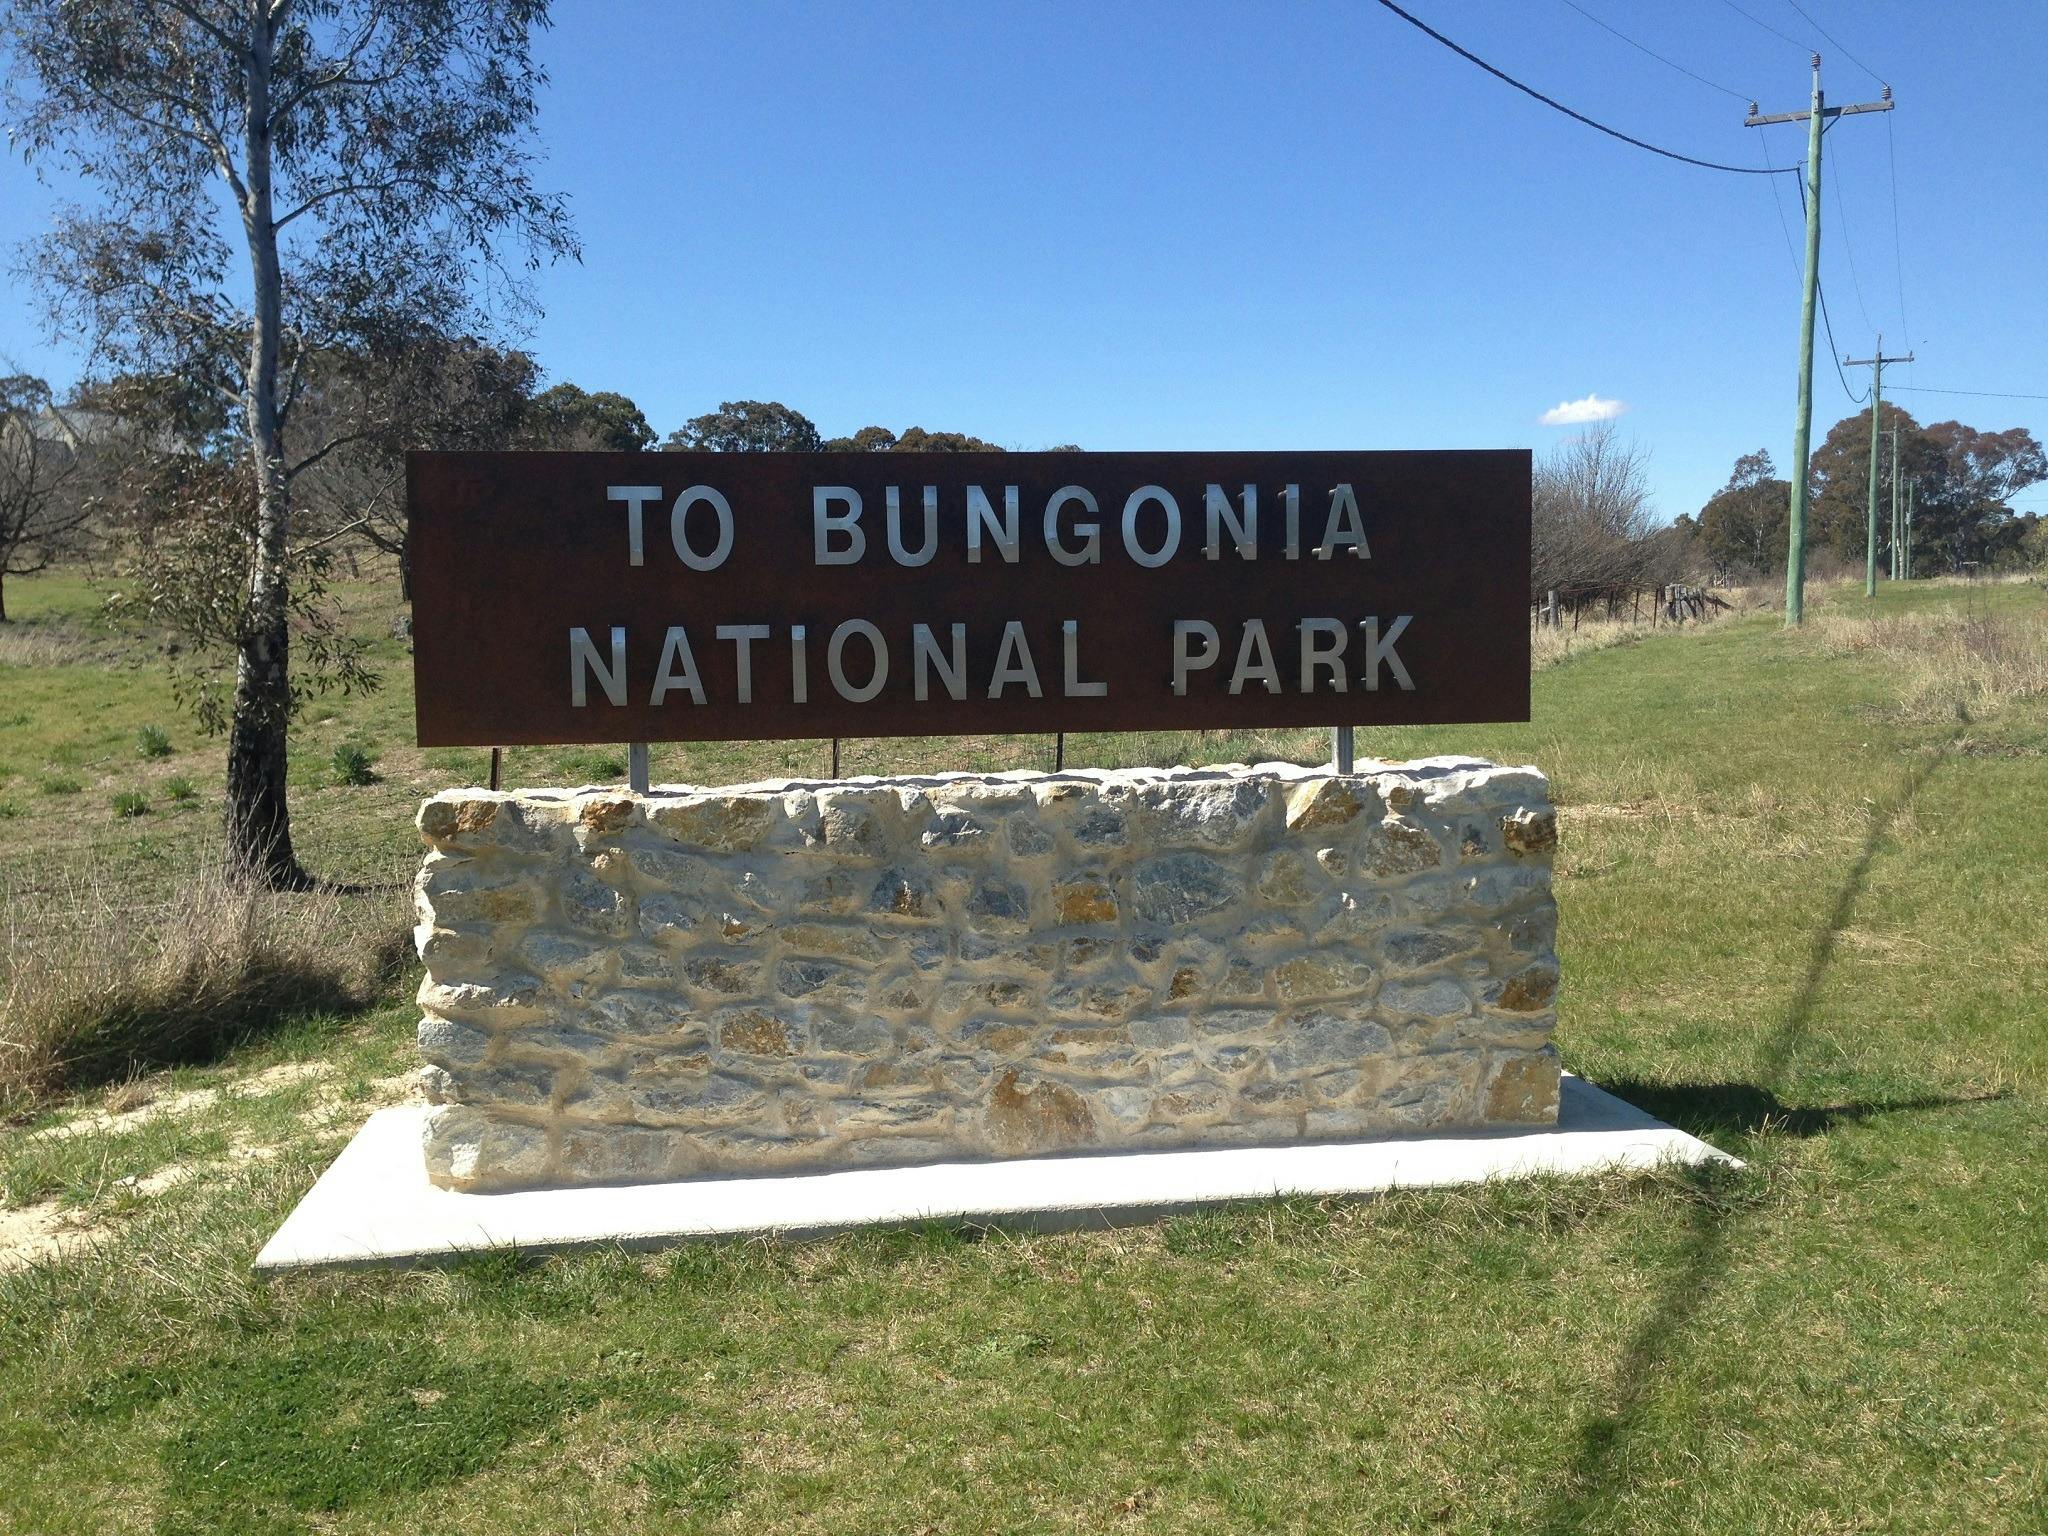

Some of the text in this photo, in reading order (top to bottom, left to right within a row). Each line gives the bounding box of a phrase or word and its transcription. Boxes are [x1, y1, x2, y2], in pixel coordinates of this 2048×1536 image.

[606, 483, 1372, 572] TO BUNGONIA
[569, 616, 1416, 707] NATIONAL PARK
